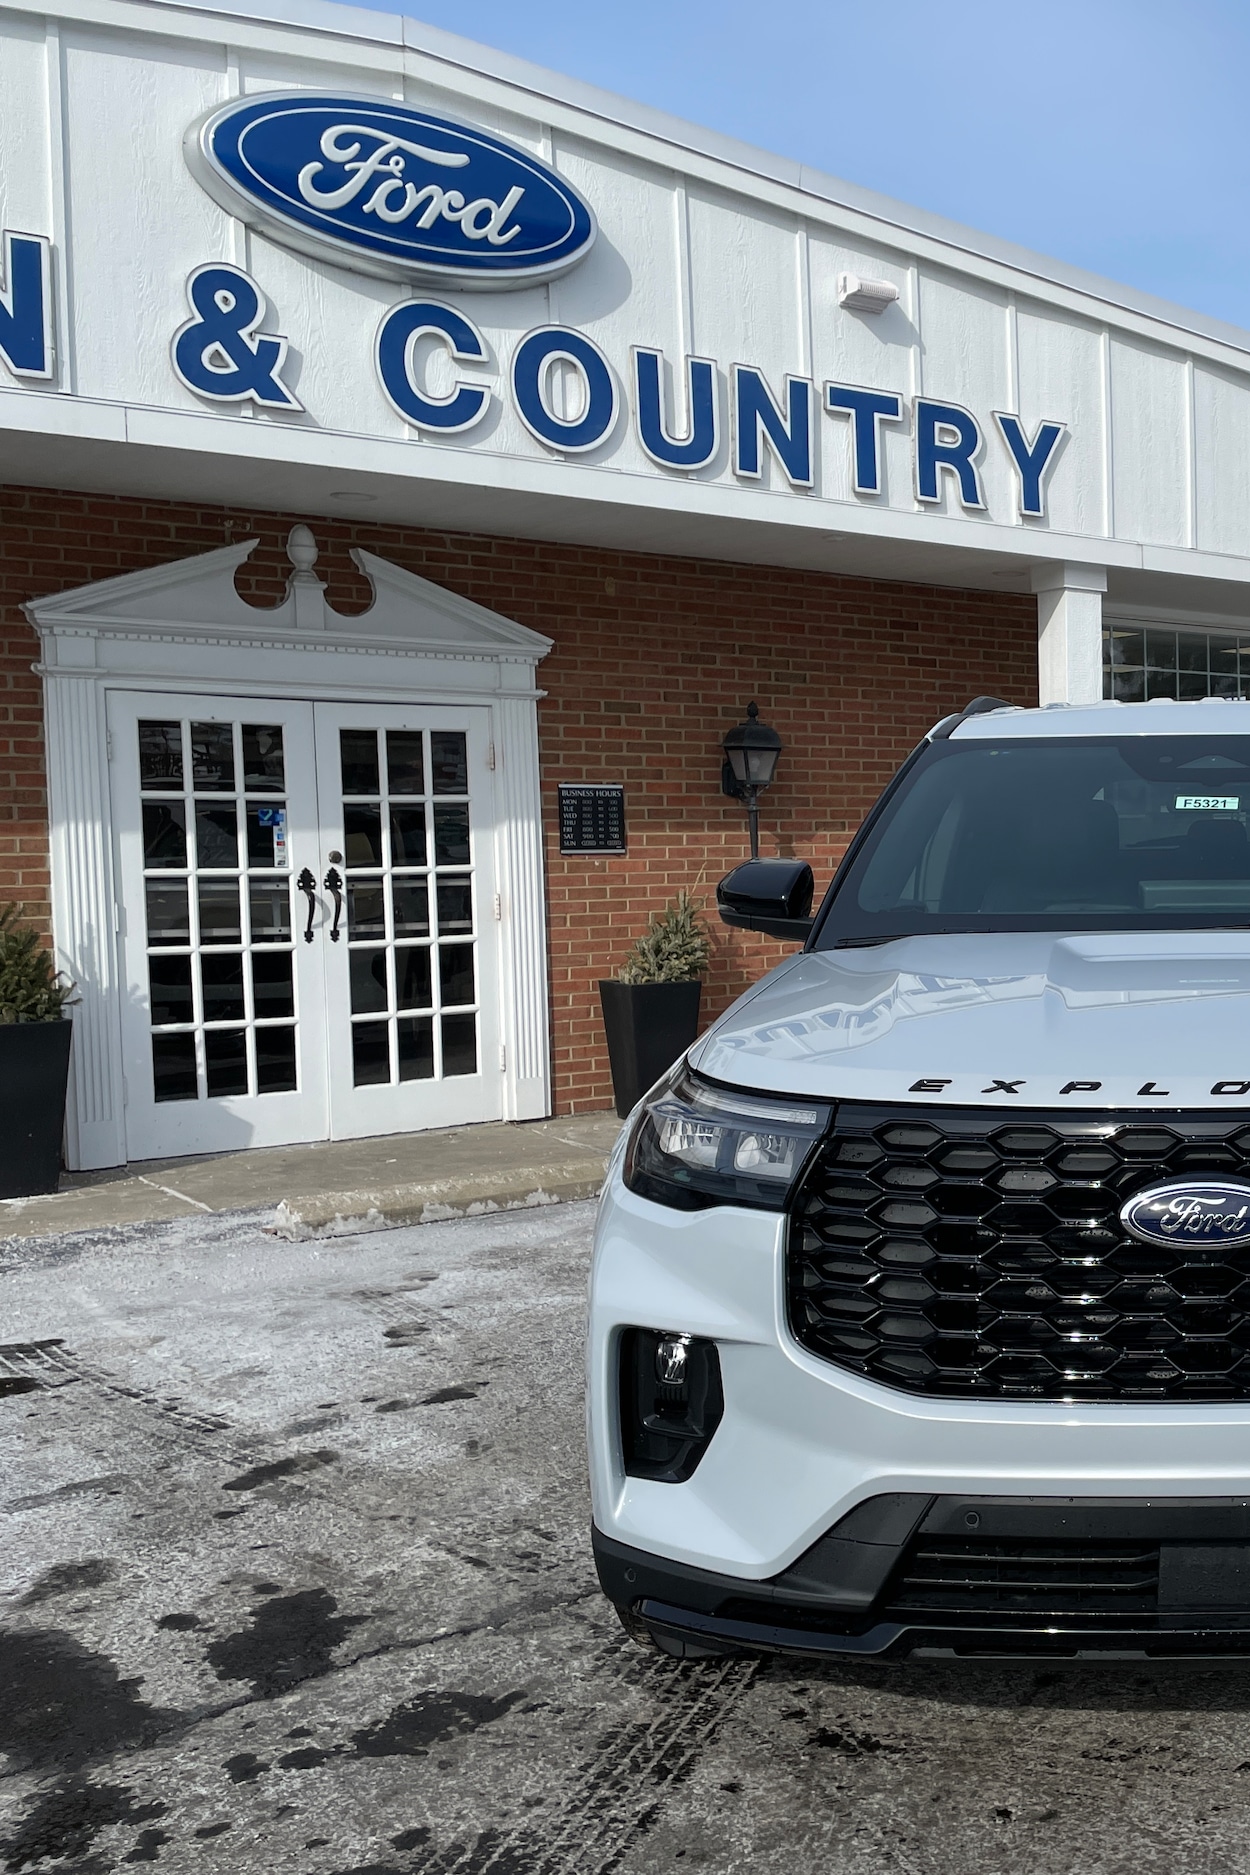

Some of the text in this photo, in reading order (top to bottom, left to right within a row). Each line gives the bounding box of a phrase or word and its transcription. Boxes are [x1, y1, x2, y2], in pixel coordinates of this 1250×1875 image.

[297, 123, 526, 247] Ford
[172, 266, 299, 407] &
[376, 300, 1065, 515] COUNTRY
[561, 789, 594, 797] BUSINESS
[1183, 799, 1227, 808] F5321
[1160, 1196, 1249, 1234] Ford
